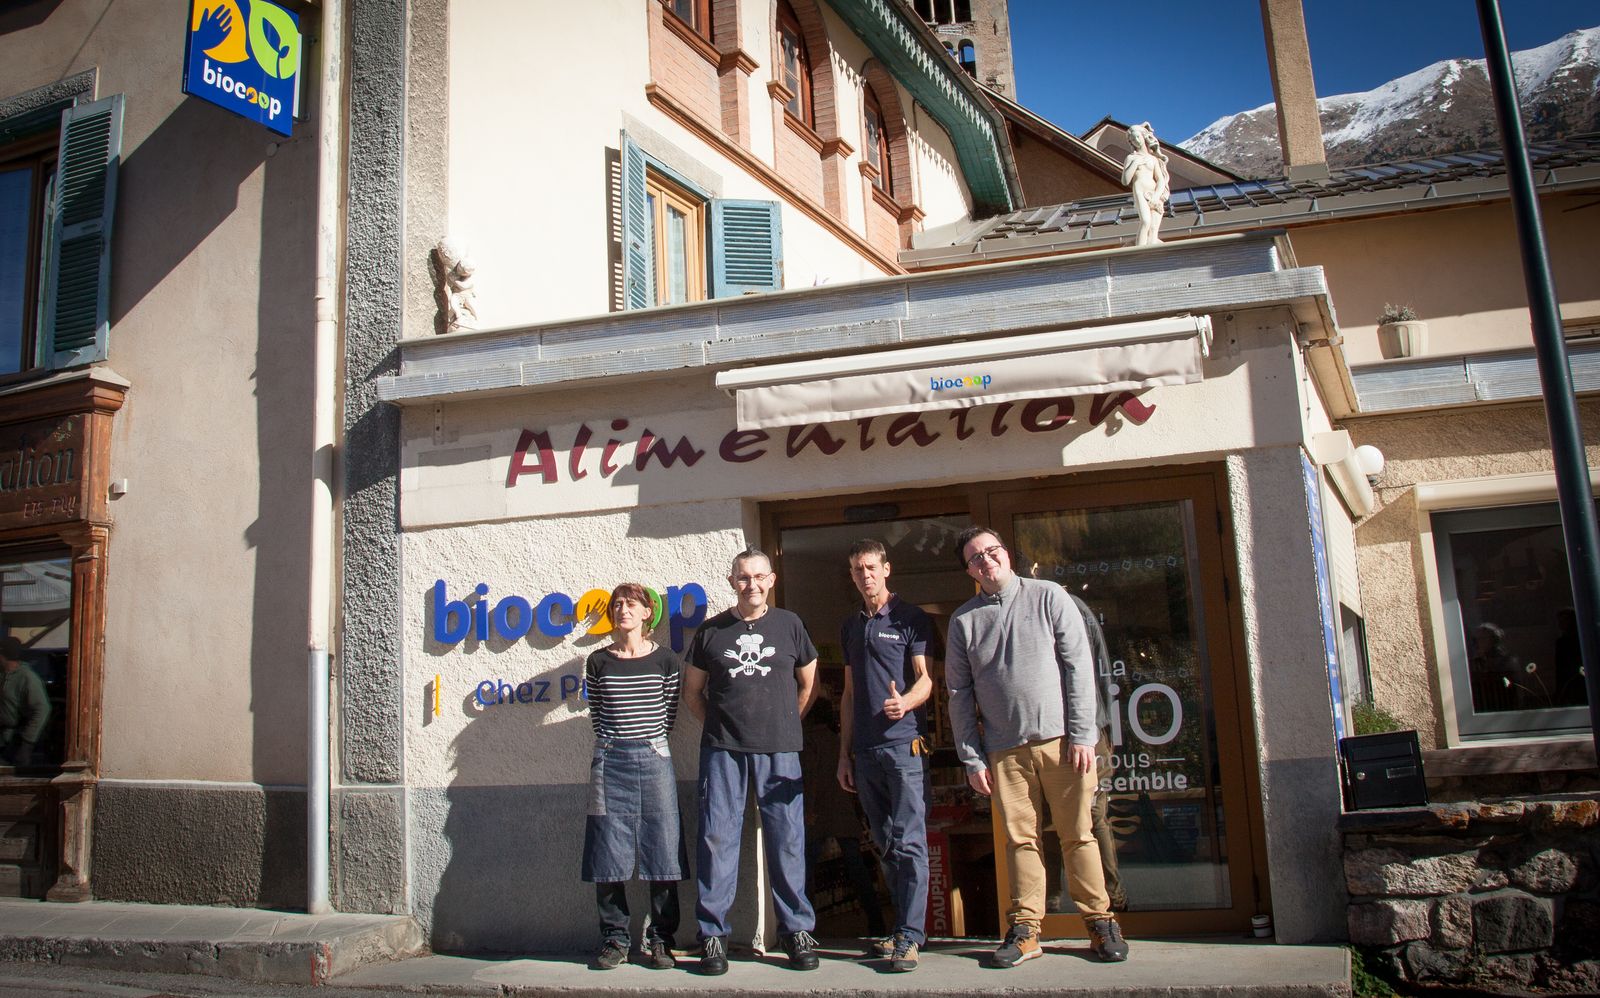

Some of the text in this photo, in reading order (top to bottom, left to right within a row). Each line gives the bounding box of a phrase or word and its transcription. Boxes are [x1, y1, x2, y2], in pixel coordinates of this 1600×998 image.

[203, 59, 281, 120] biocoop
[930, 375, 991, 390] biocoop
[1099, 659, 1126, 677] La
[476, 679, 550, 706] Chez
[1094, 771, 1188, 792] semble
